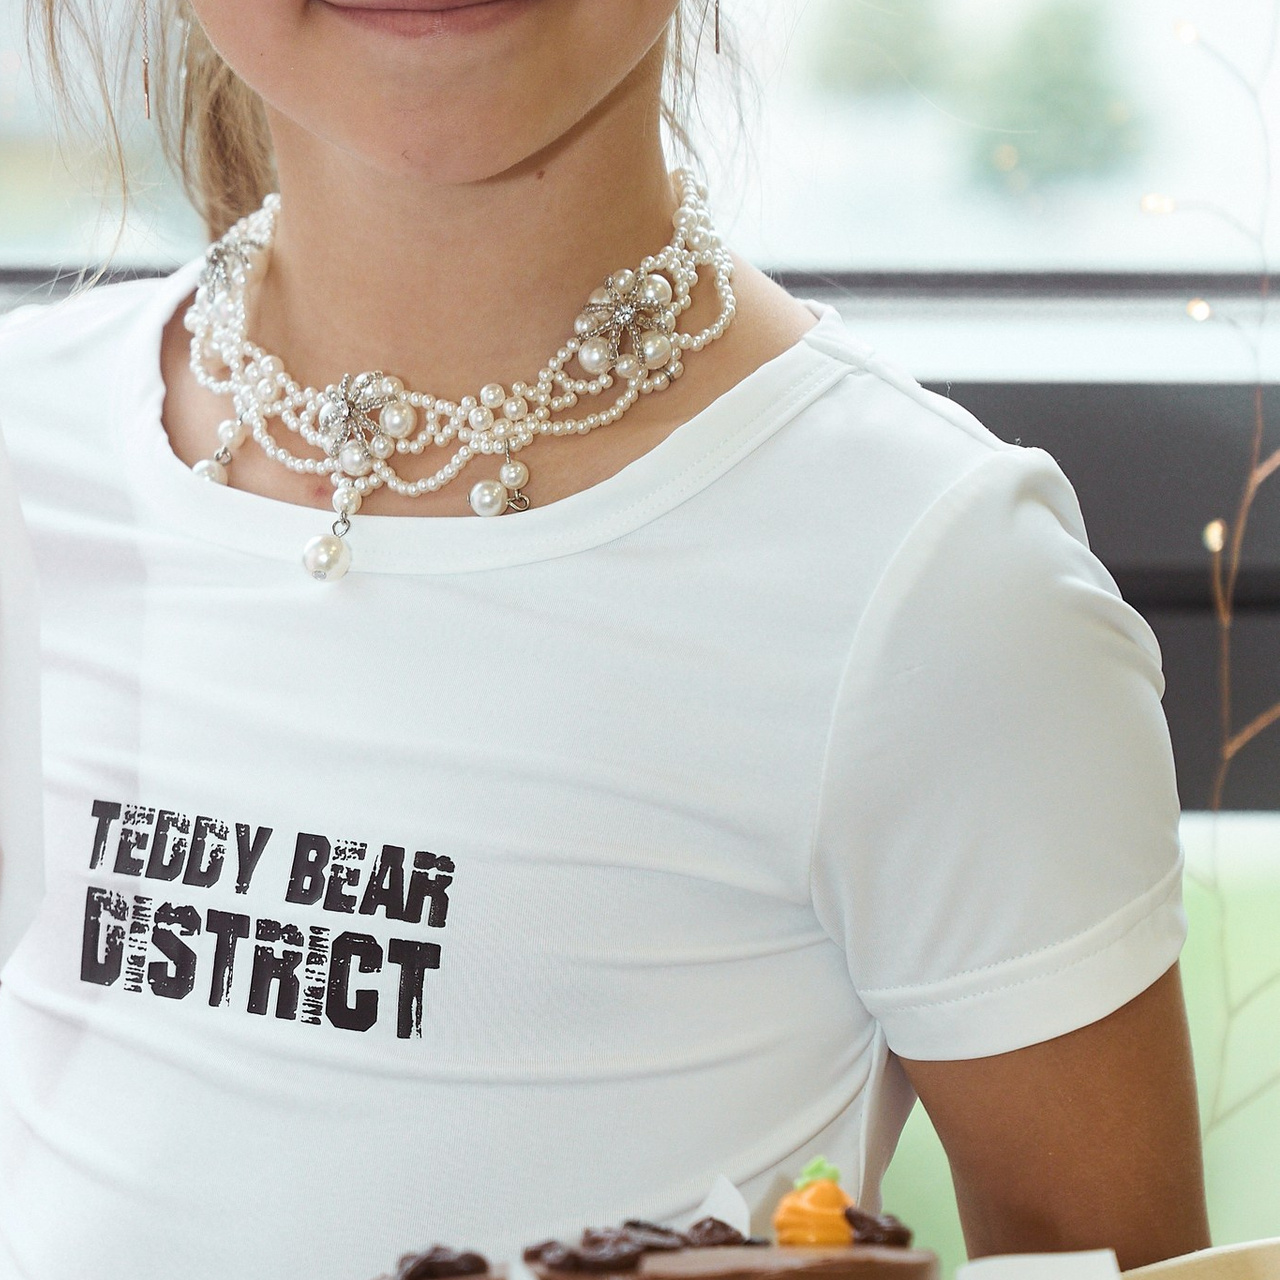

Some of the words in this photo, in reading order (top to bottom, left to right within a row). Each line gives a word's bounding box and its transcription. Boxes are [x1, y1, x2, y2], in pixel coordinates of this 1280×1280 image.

[89, 799, 273, 895] TEDDY
[285, 832, 455, 928] BEAR
[80, 886, 441, 1039] DISTRICT
